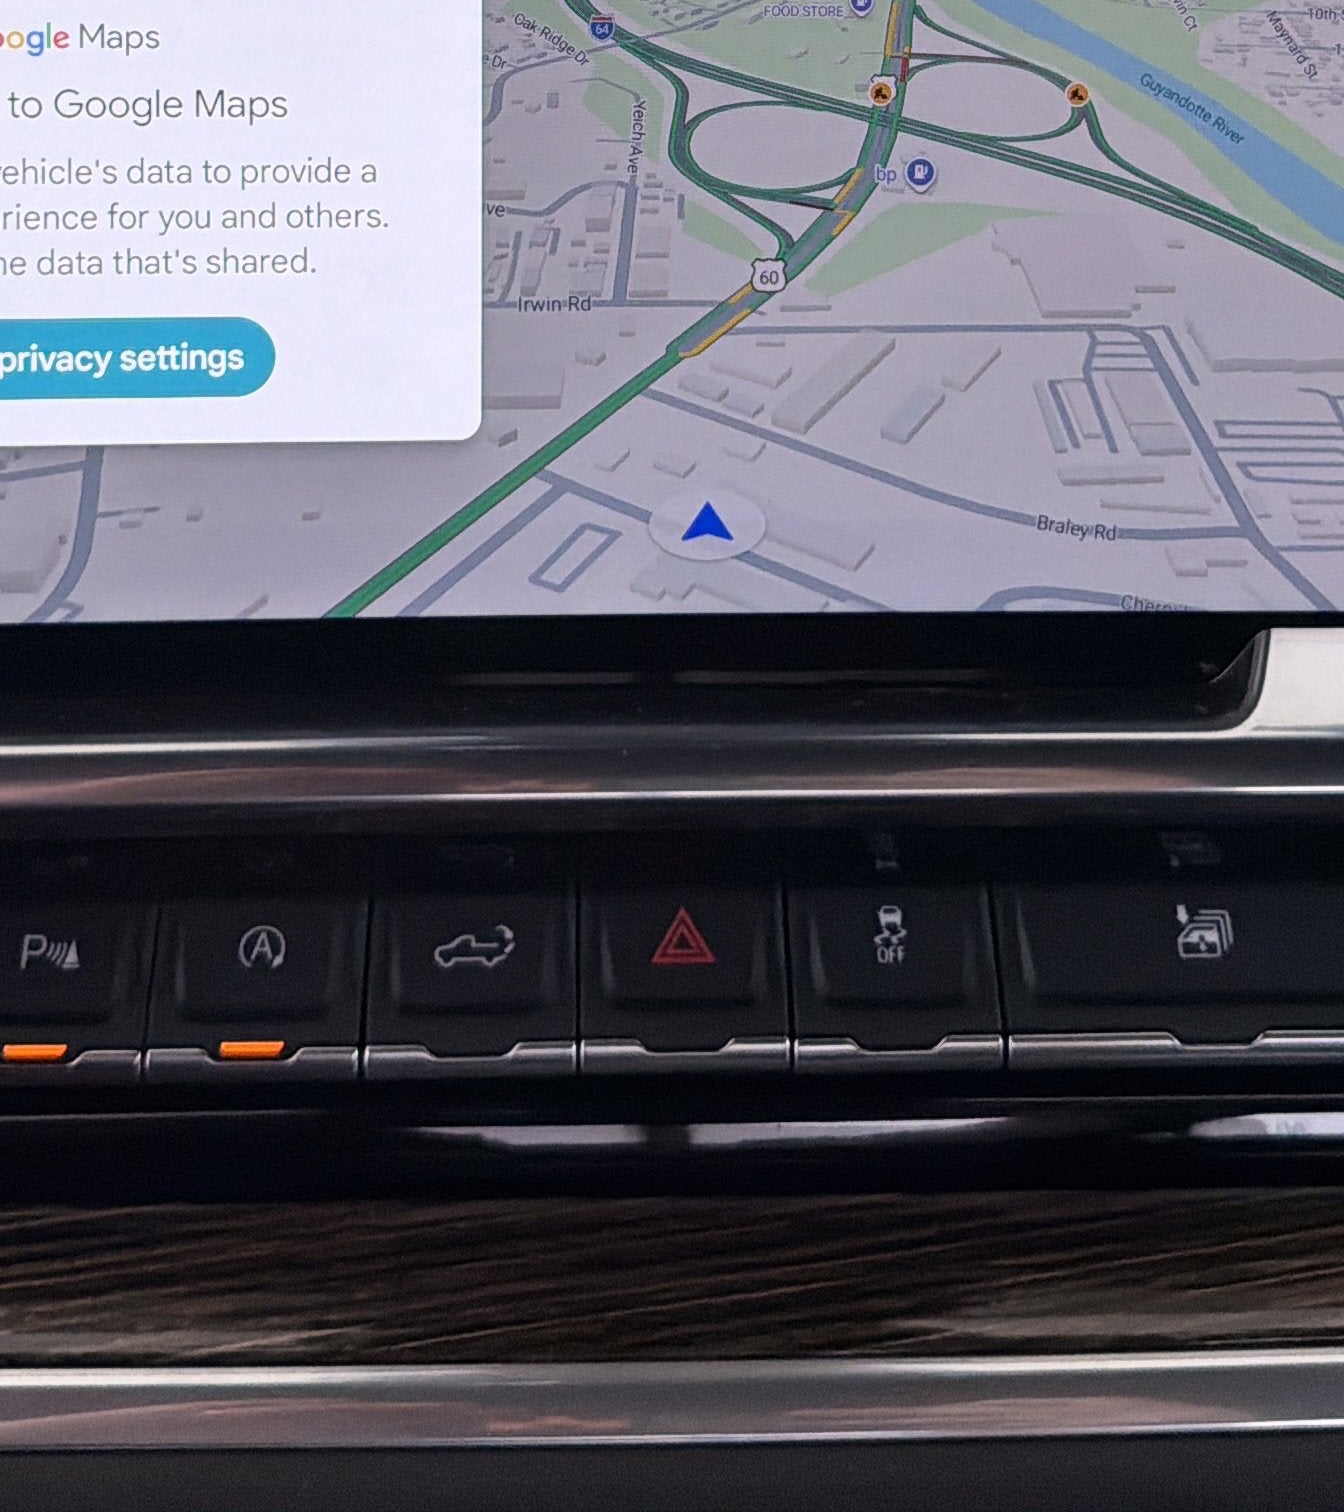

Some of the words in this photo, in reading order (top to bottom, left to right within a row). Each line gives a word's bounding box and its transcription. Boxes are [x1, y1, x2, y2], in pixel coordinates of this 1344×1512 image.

[763, 5, 798, 17] FOOD
[802, 5, 844, 17] STORE
[1183, 15, 1198, 33] Ct
[1307, 8, 1337, 21] 10th
[80, 24, 159, 56] Maps
[514, 12, 538, 33] Oak
[539, 25, 576, 56] Ridge
[574, 50, 591, 66] Dr
[595, 24, 609, 34] 64
[1267, 10, 1305, 66] Maynard
[1302, 63, 1318, 81] St
[492, 55, 508, 70] Dr
[7, 92, 42, 118] to
[54, 89, 182, 126] Google
[196, 90, 288, 126] Maps
[1140, 72, 1213, 123] Guyandotte
[1212, 116, 1246, 145] River
[627, 145, 644, 174] Ave
[127, 157, 191, 184] data
[202, 160, 231, 183] to
[241, 157, 350, 190] provide
[361, 164, 376, 183] a
[875, 165, 897, 183] bp
[107, 202, 149, 229] for
[159, 210, 210, 236] you
[222, 202, 275, 228] and
[287, 201, 389, 228] others.
[486, 203, 506, 218] ve
[37, 248, 102, 275] data
[113, 248, 197, 274] that's
[207, 247, 316, 274] shared.
[759, 270, 779, 285] 60
[518, 295, 562, 312] Irwin
[567, 295, 592, 312] Rd
[120, 342, 245, 379] settings
[1036, 514, 1090, 541] Braley
[1094, 524, 1117, 541] Rd
[877, 945, 904, 964] OFF
